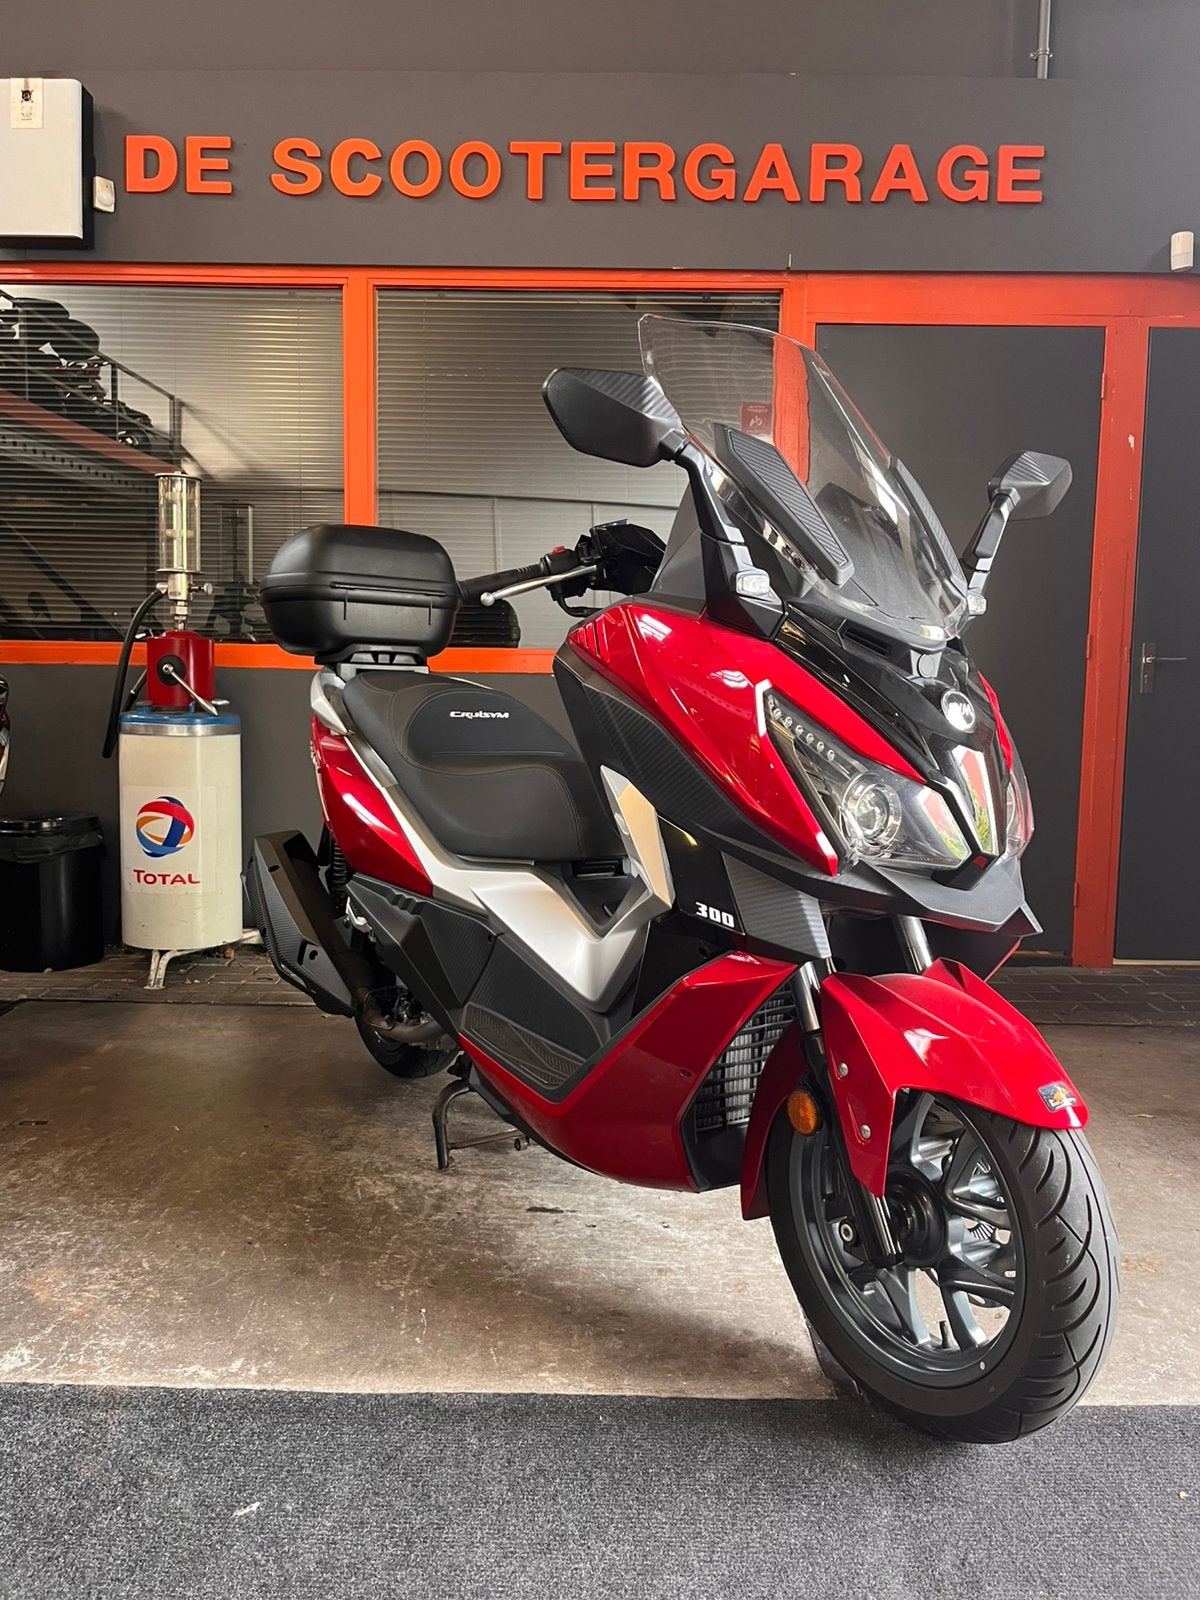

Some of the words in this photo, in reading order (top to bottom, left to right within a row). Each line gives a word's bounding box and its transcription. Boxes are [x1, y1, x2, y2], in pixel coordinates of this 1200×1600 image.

[125, 134, 233, 194] DE
[270, 137, 1045, 203] SCOOTERGARAGE
[133, 869, 201, 885] TOTAL
[695, 901, 735, 928] 300
